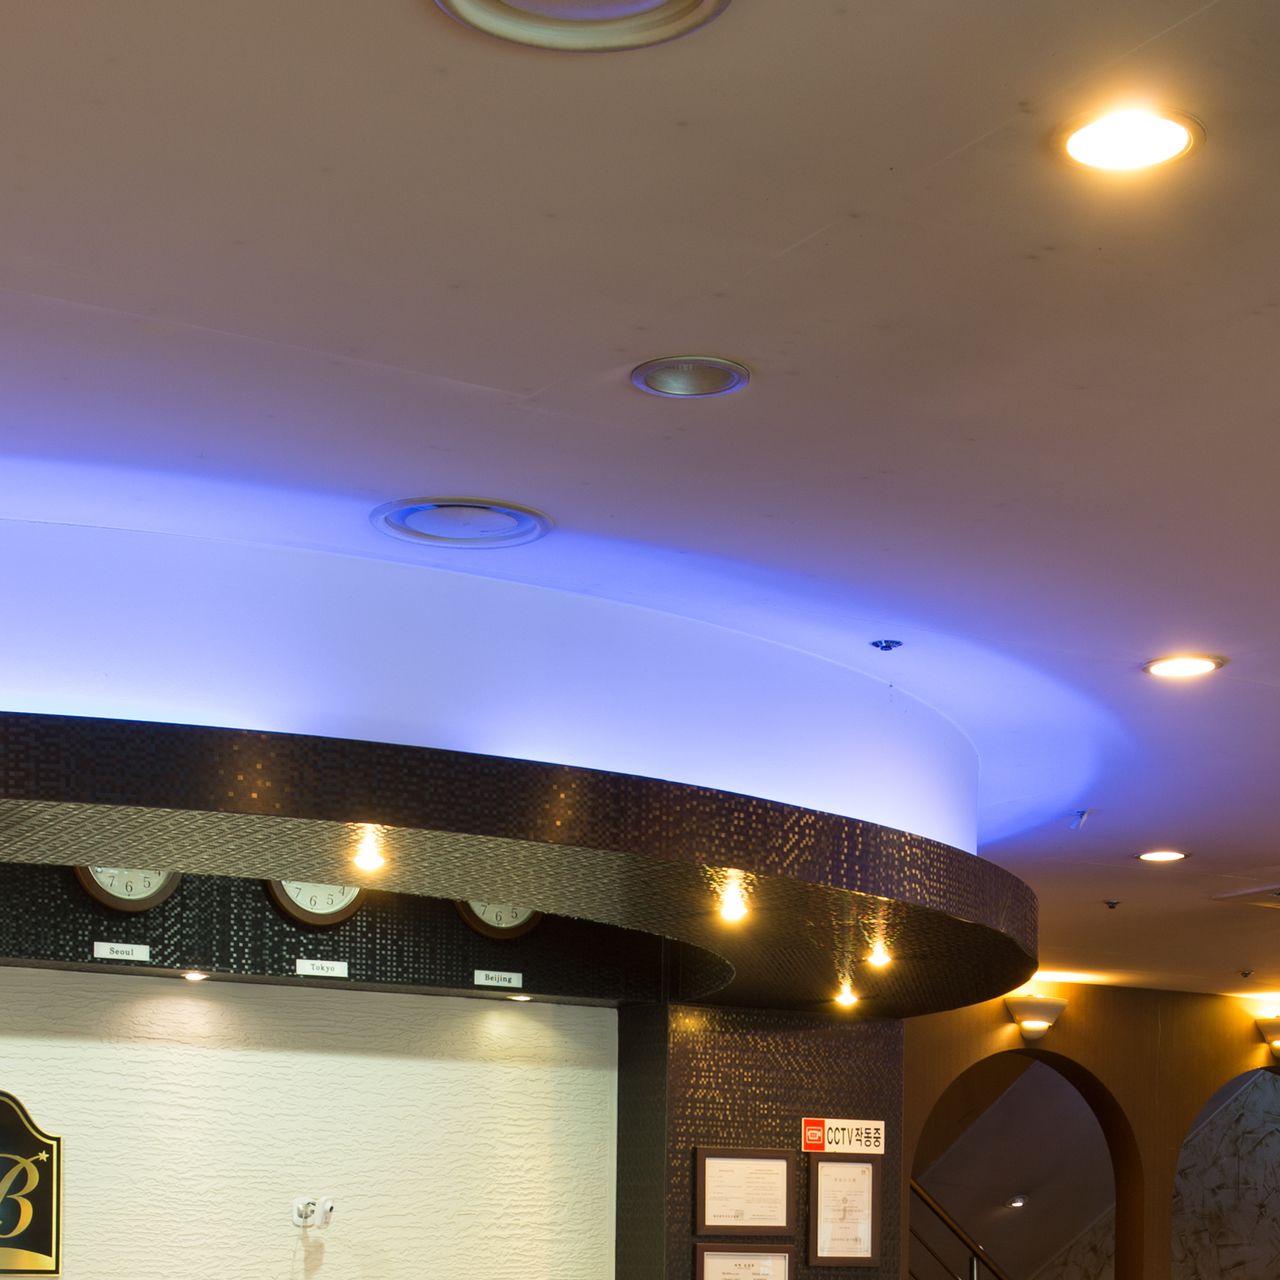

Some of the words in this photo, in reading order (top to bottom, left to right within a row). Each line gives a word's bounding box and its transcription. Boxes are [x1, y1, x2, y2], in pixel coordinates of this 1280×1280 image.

[125, 880, 134, 894] 6
[143, 876, 152, 889] 5
[309, 895, 318, 908] 6
[326, 894, 335, 906] 5
[495, 910, 503, 922] 6
[511, 908, 519, 920] 5
[109, 947, 134, 957] Seoul
[311, 963, 335, 974] Tokyo
[484, 973, 513, 984] Beijing
[826, 1126, 881, 1148] CCTV작동중
